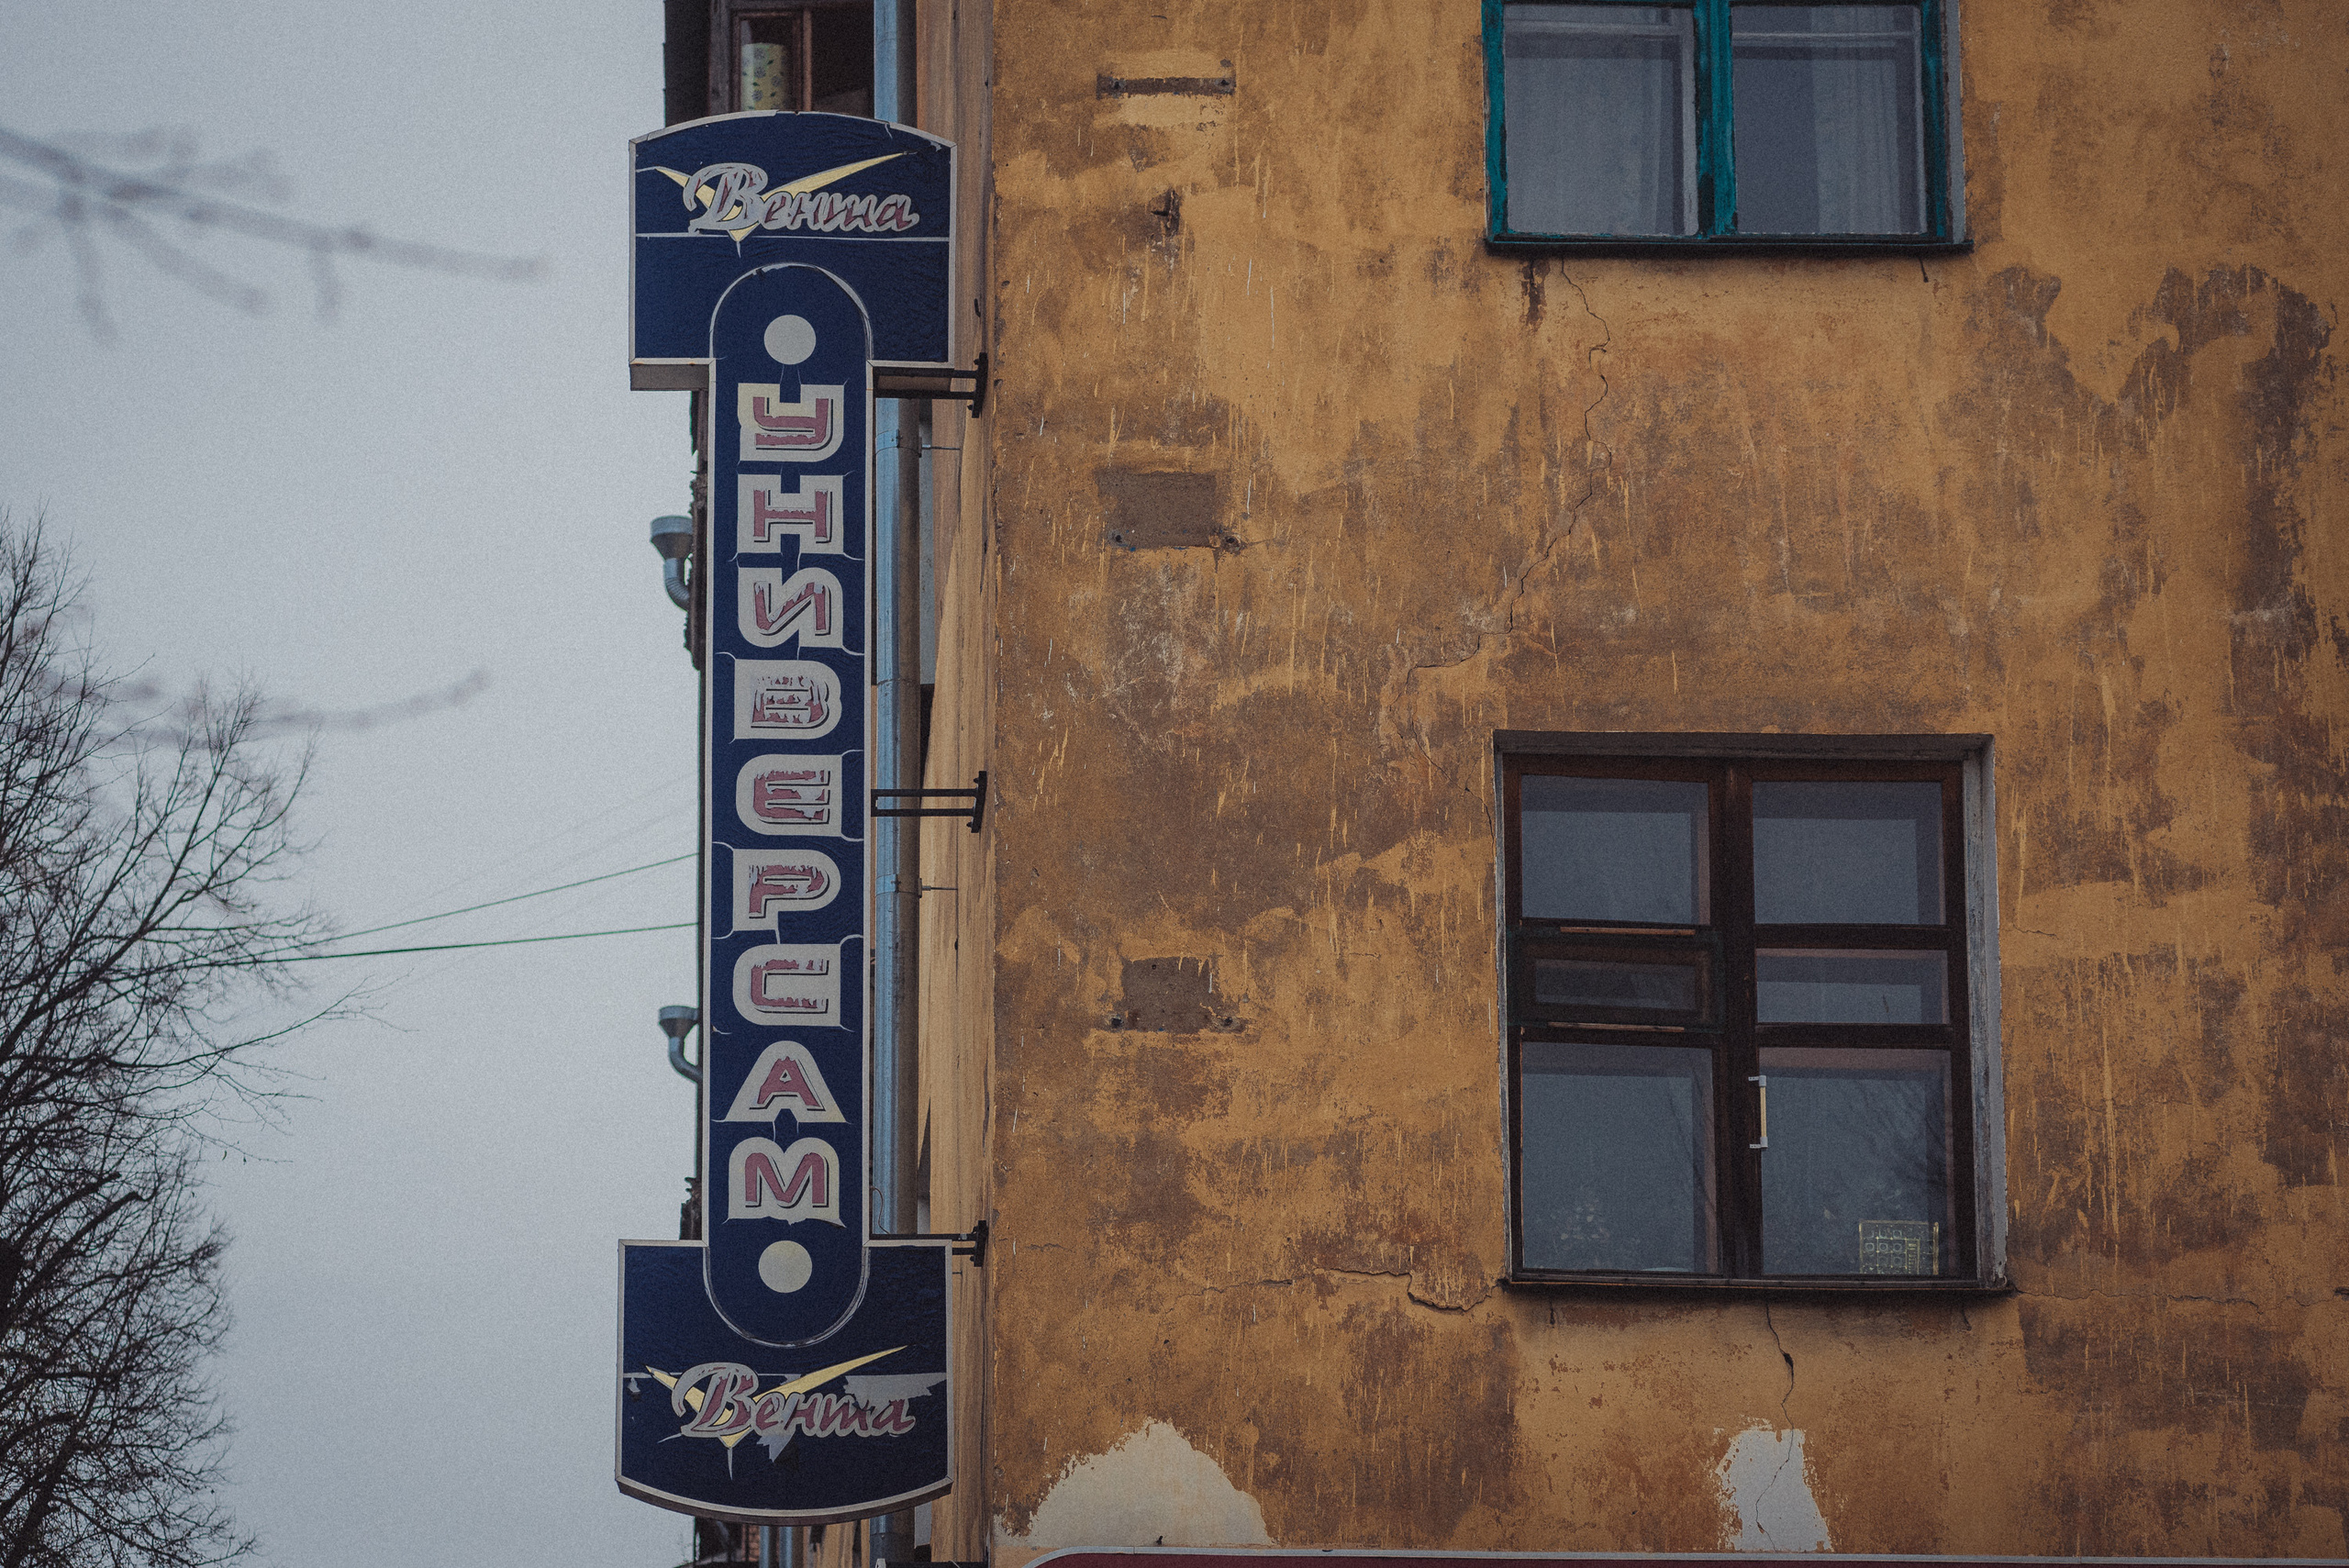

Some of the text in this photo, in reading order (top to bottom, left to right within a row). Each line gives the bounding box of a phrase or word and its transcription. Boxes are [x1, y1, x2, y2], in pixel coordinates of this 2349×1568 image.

[683, 162, 919, 232] Вента
[728, 384, 845, 1221] УНИВЕРСАМ
[672, 1362, 916, 1439] Вента
